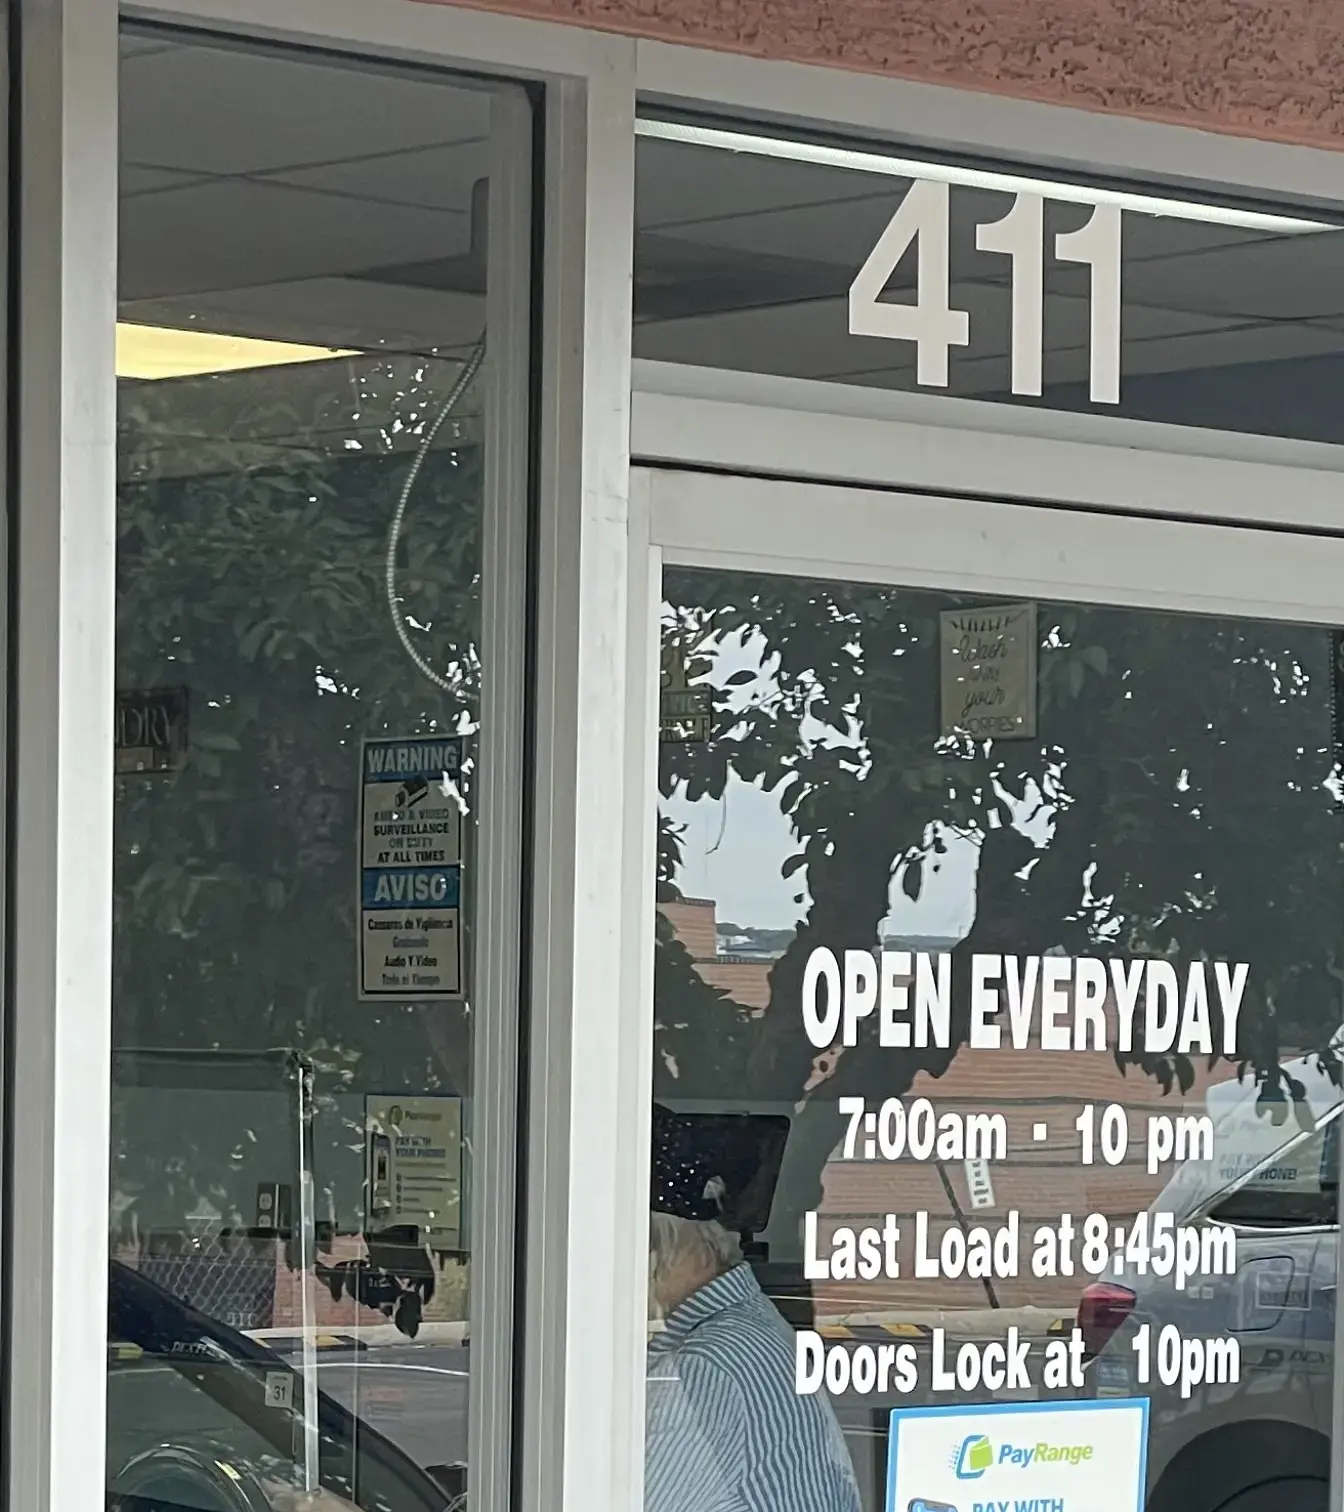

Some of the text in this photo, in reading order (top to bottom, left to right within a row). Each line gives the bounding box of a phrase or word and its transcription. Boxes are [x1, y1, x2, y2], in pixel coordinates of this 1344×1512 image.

[848, 178, 1122, 405] 411
[961, 686, 1007, 717] your
[367, 746, 457, 774] WARNING
[419, 808, 449, 819] VIDEO
[374, 823, 449, 836] SURVEILLANCE
[378, 850, 445, 863] AT ALL TIMES
[375, 873, 447, 902] AVISO
[384, 955, 406, 967] Audio
[408, 956, 413, 966] Y
[801, 945, 1250, 1054] OPEN EVERYDAY
[839, 1096, 1006, 1161] 7:00am
[1076, 1103, 1128, 1166] 10
[1147, 1113, 1214, 1174] pm
[803, 1211, 1236, 1289] Last Load at 8:45pm
[795, 1324, 1241, 1399] Doors Lock at 10pm
[273, 1386, 286, 1401] 31
[998, 1442, 1093, 1466] PayRange
